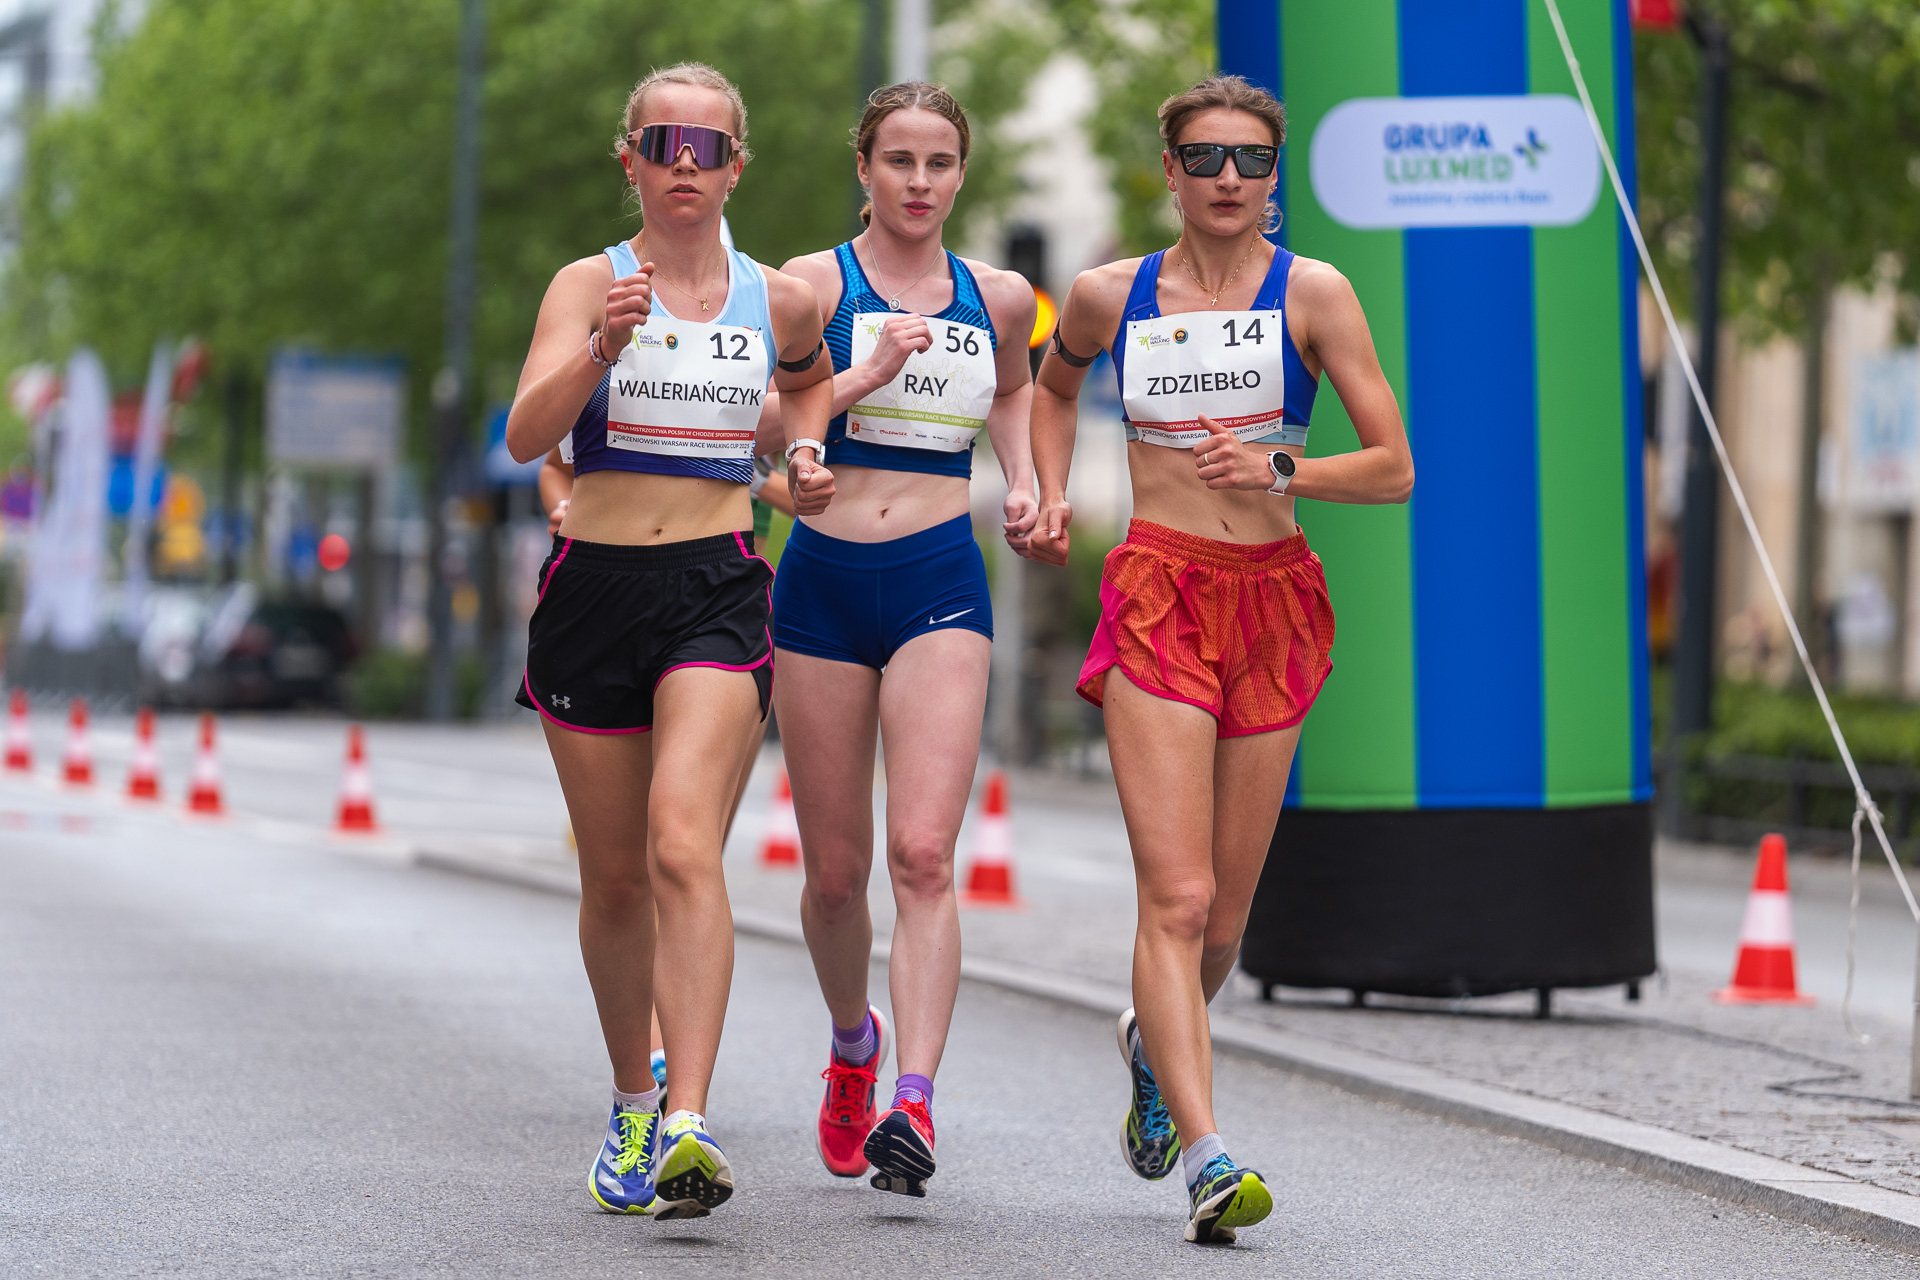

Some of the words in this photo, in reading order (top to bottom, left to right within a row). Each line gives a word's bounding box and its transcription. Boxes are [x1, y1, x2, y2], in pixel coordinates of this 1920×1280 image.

[1384, 123, 1491, 151] GRUPA
[945, 325, 979, 356] 56
[1150, 337, 1170, 345] WALKING
[1222, 318, 1264, 347] 14
[710, 332, 750, 360] 12
[618, 379, 761, 406] WALERIAŃCZYK
[904, 373, 949, 397] RAY
[1147, 369, 1261, 396] ZDZIEBŁO
[851, 406, 897, 416] KORZENIOWSKI
[898, 411, 925, 419] WARSAW
[940, 416, 964, 425] WALKING
[1233, 414, 1267, 425] SPORTOWYM
[1266, 411, 1278, 419] 2025
[616, 423, 629, 431] PZLA
[630, 426, 667, 435] MISTRZOSTWA
[1141, 429, 1179, 440] KORZENIOWSKI
[1179, 432, 1208, 440] WARSAW
[1232, 427, 1254, 435] ALKING
[1267, 420, 1280, 428] 2025
[613, 434, 660, 446] KORZENIOWSKI
[689, 441, 705, 449] RACE
